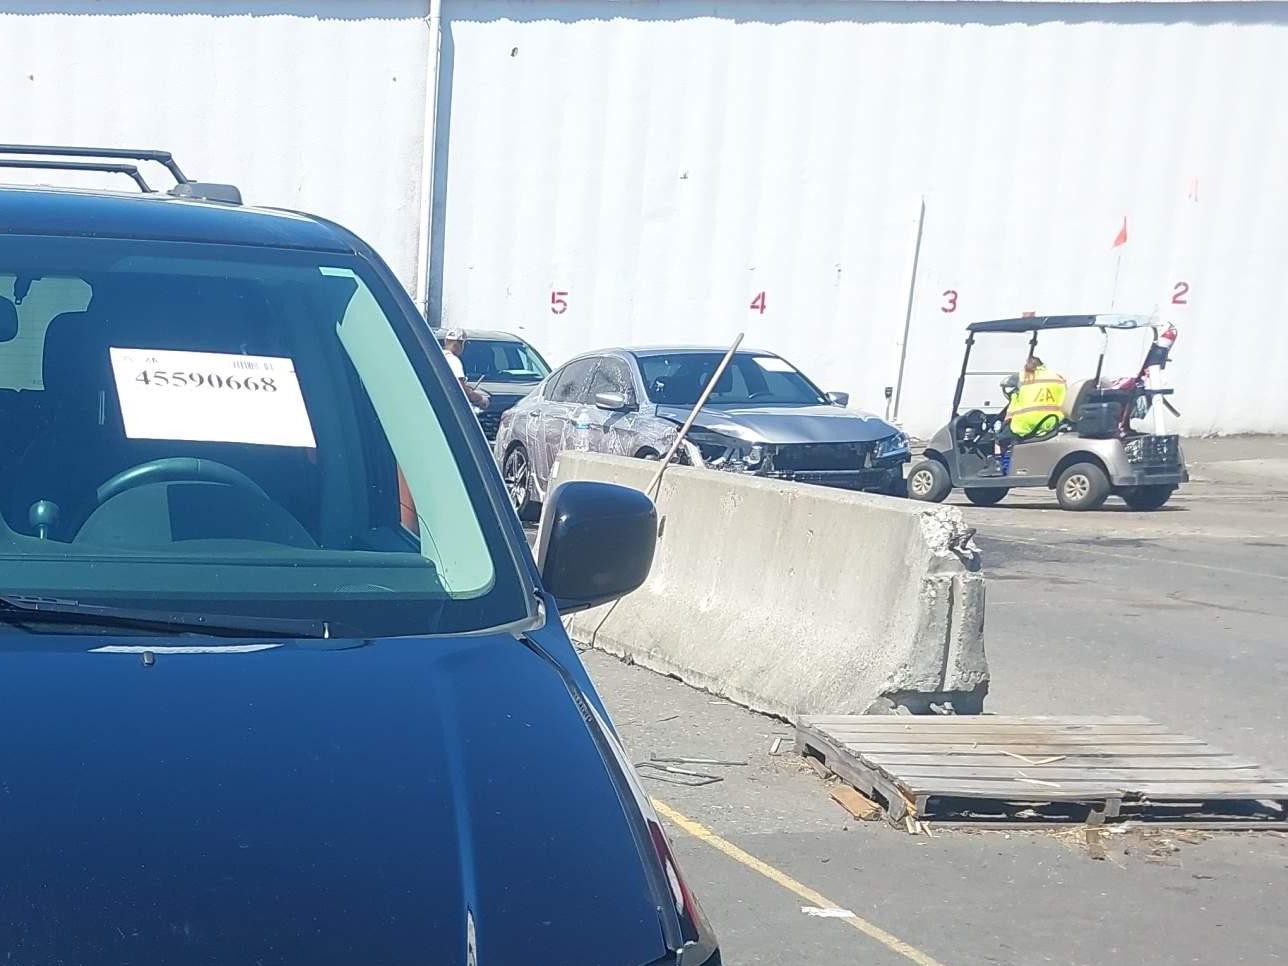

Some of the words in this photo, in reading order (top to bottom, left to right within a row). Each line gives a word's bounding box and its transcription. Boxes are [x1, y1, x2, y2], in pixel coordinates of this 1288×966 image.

[551, 291, 569, 315] 5
[750, 291, 767, 315] 4
[940, 290, 959, 313] 3
[1171, 281, 1190, 305] 2
[135, 369, 278, 393] 45590668
